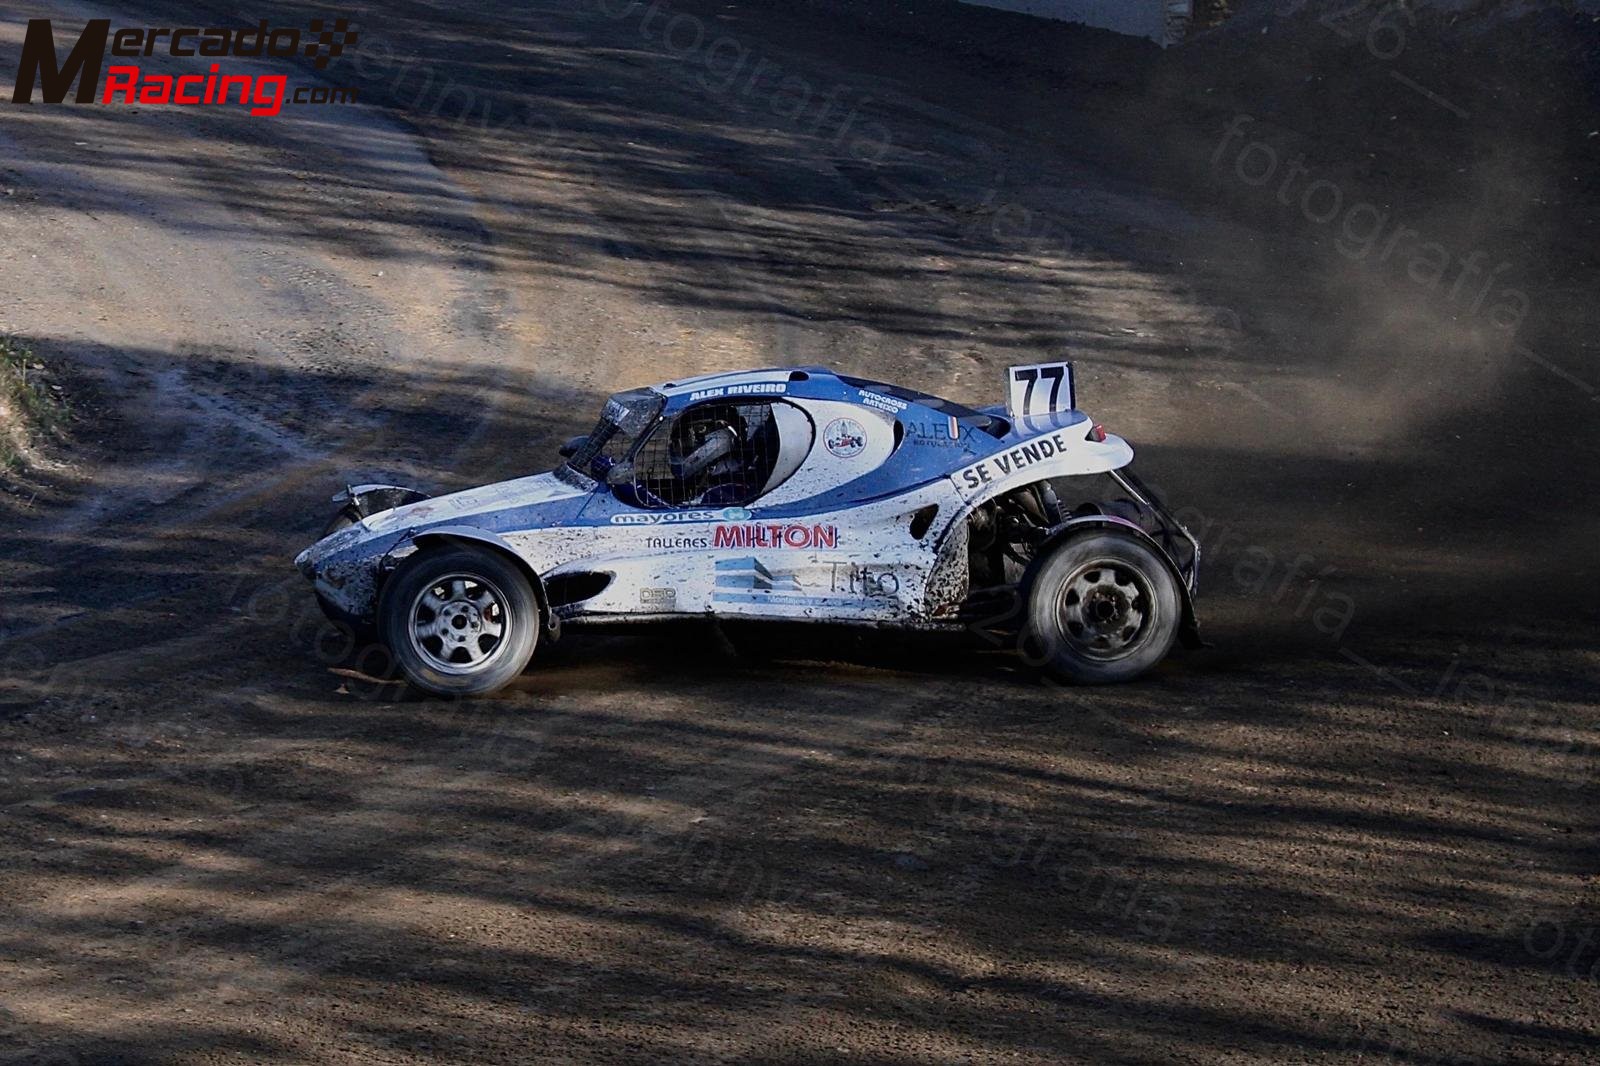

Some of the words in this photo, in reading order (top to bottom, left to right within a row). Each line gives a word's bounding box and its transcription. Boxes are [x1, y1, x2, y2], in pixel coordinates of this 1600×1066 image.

[690, 388, 724, 401] ALEX
[727, 383, 786, 395] RIVEIRO
[858, 389, 907, 410] AUTOCROSS
[1015, 366, 1064, 415] 77
[963, 464, 992, 489] SE
[994, 435, 1067, 475] VENDE
[615, 511, 714, 525] mayores
[713, 525, 838, 549] MILTON
